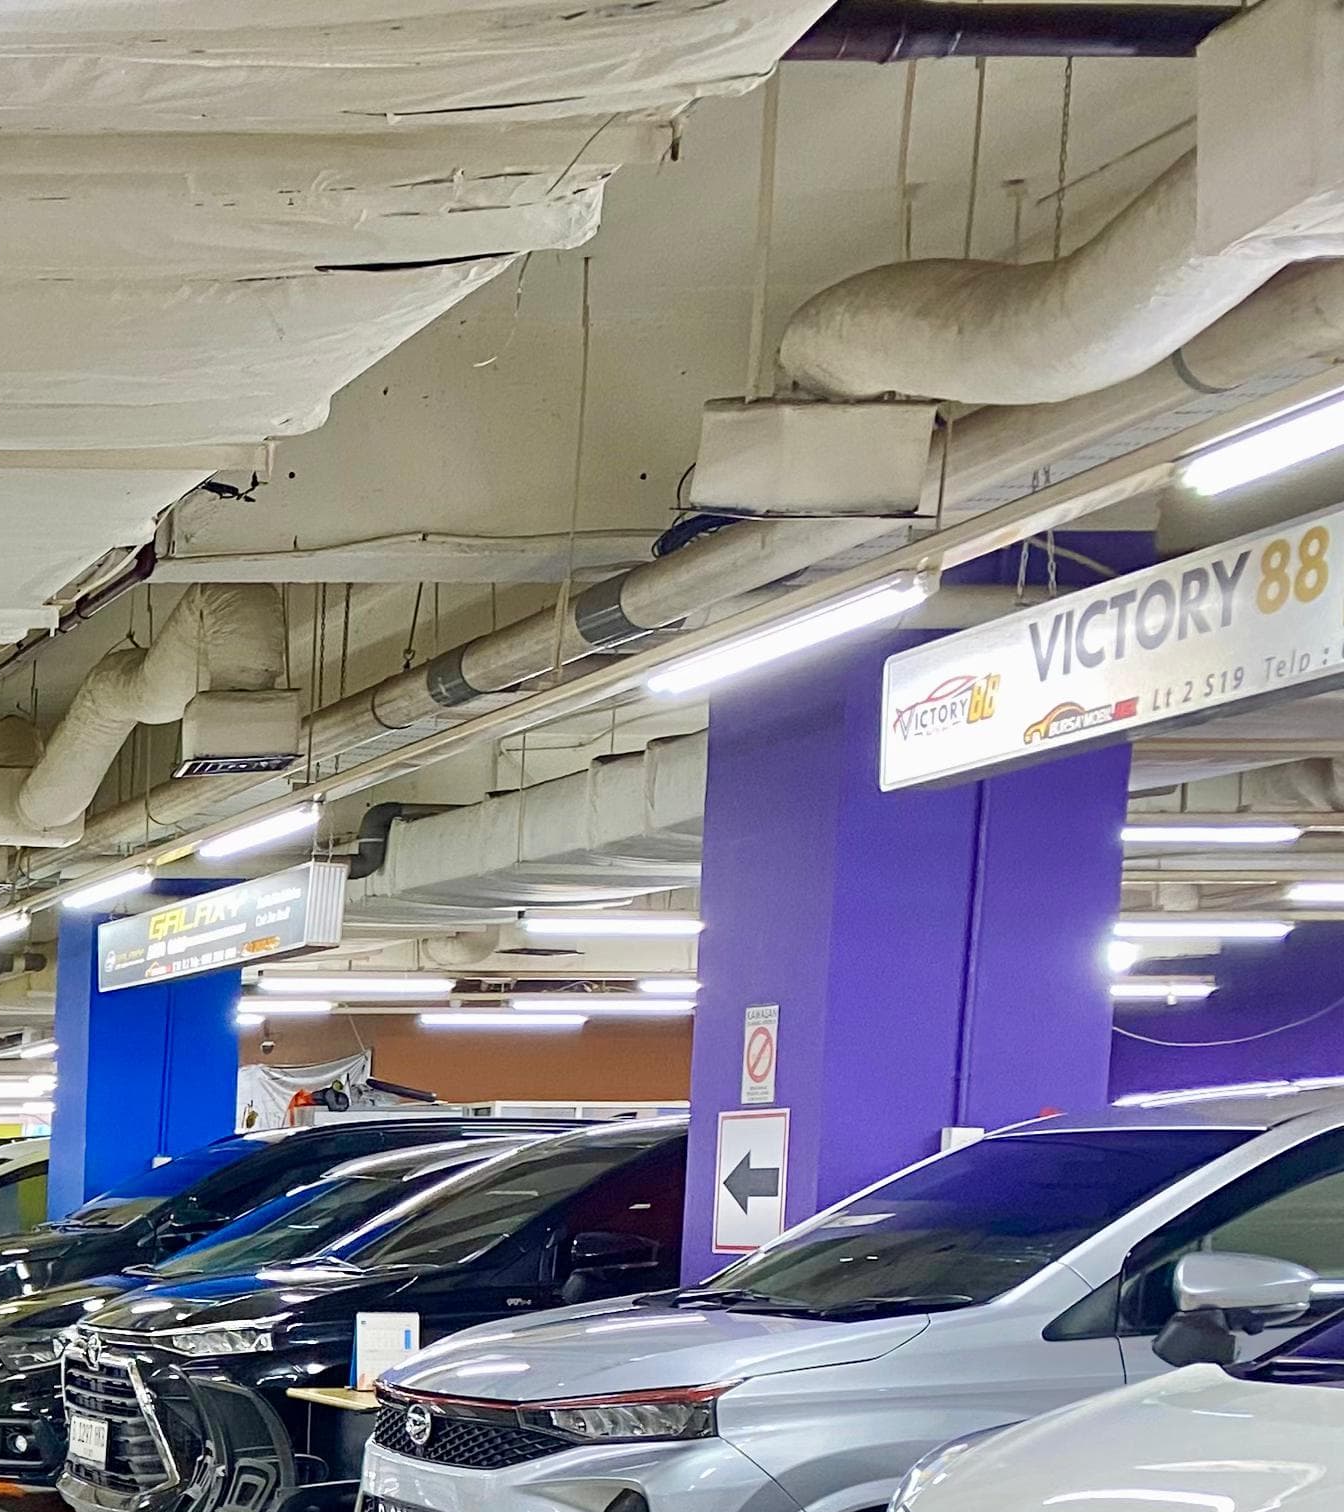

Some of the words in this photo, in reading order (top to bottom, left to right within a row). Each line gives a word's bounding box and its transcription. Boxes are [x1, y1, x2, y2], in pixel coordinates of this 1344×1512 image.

[1029, 550, 1252, 682] VICTORY
[1255, 525, 1330, 615] 88
[1182, 681, 1193, 702] 2
[1204, 667, 1245, 697] S19
[895, 698, 968, 741] VICTORY
